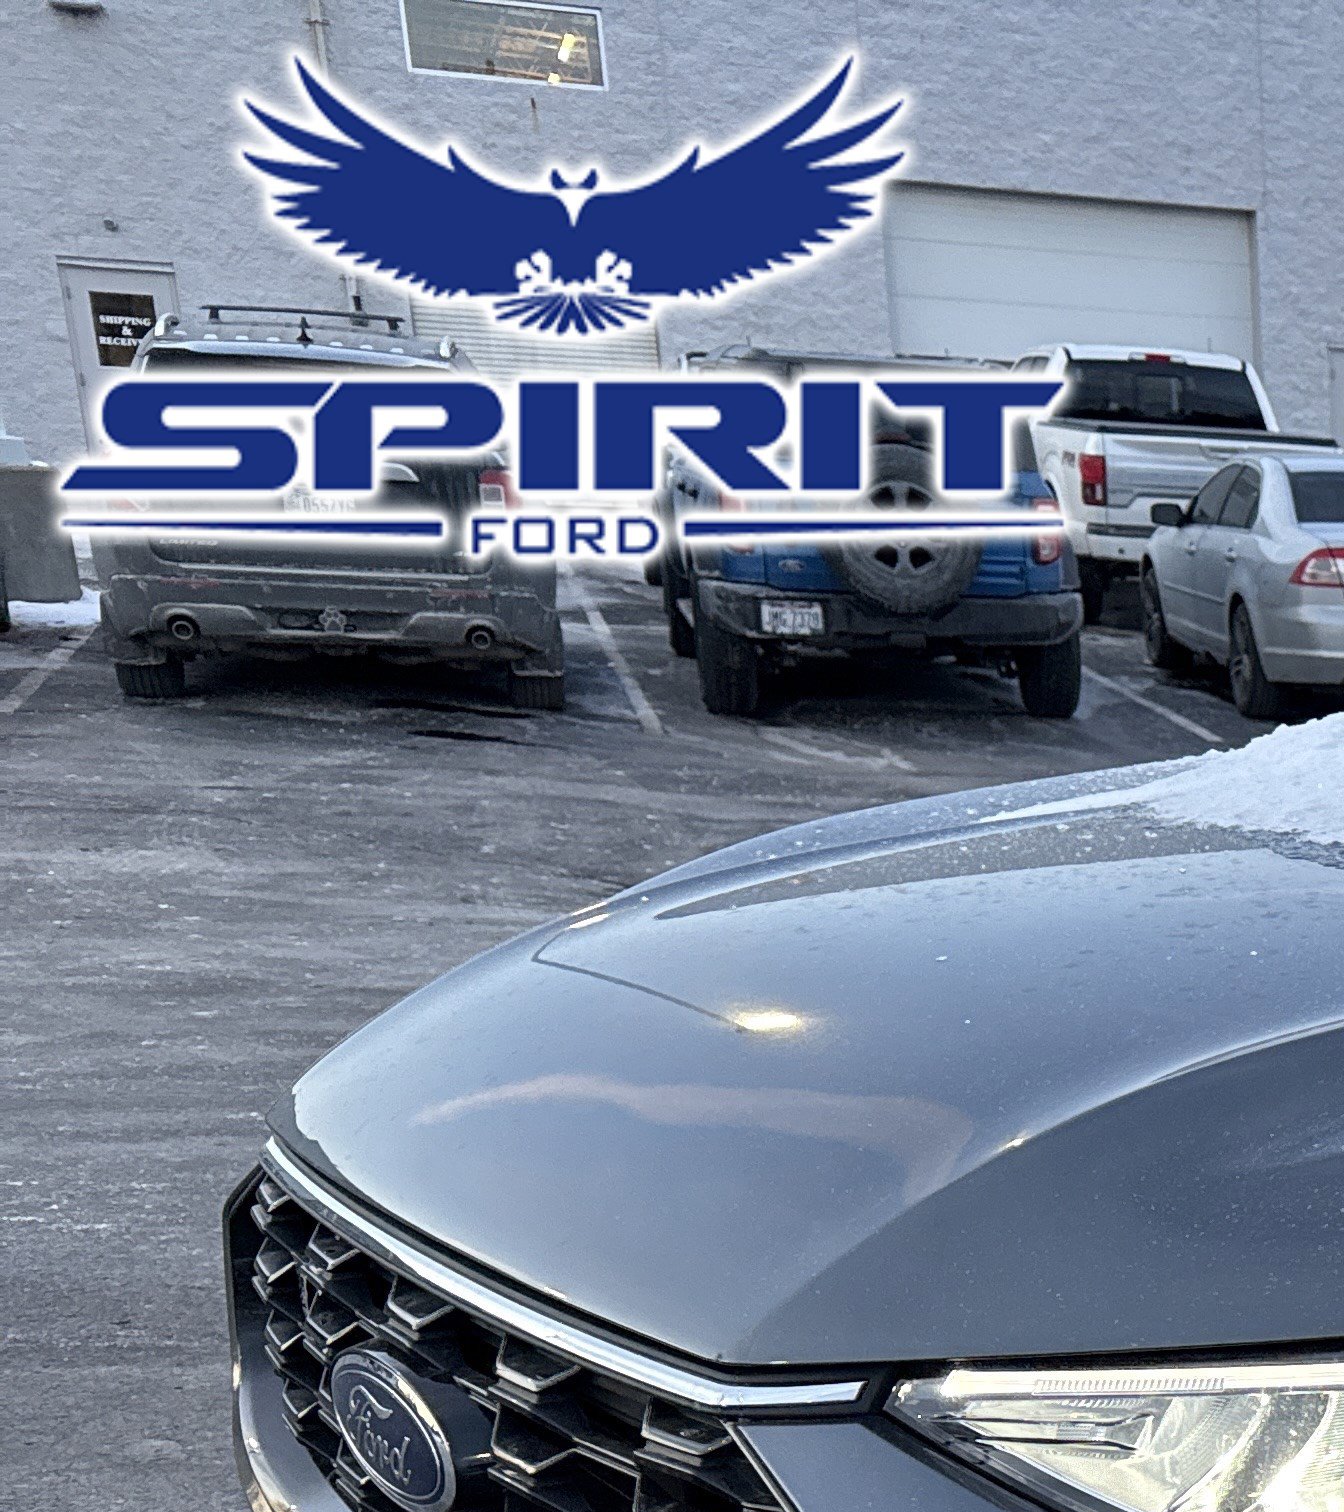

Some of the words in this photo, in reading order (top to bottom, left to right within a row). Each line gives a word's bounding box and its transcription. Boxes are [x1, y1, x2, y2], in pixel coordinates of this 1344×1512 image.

[99, 314, 151, 326] SHIPPING
[122, 326, 134, 336] &
[99, 336, 140, 347] RECEIV
[347, 1384, 412, 1486] Ford
